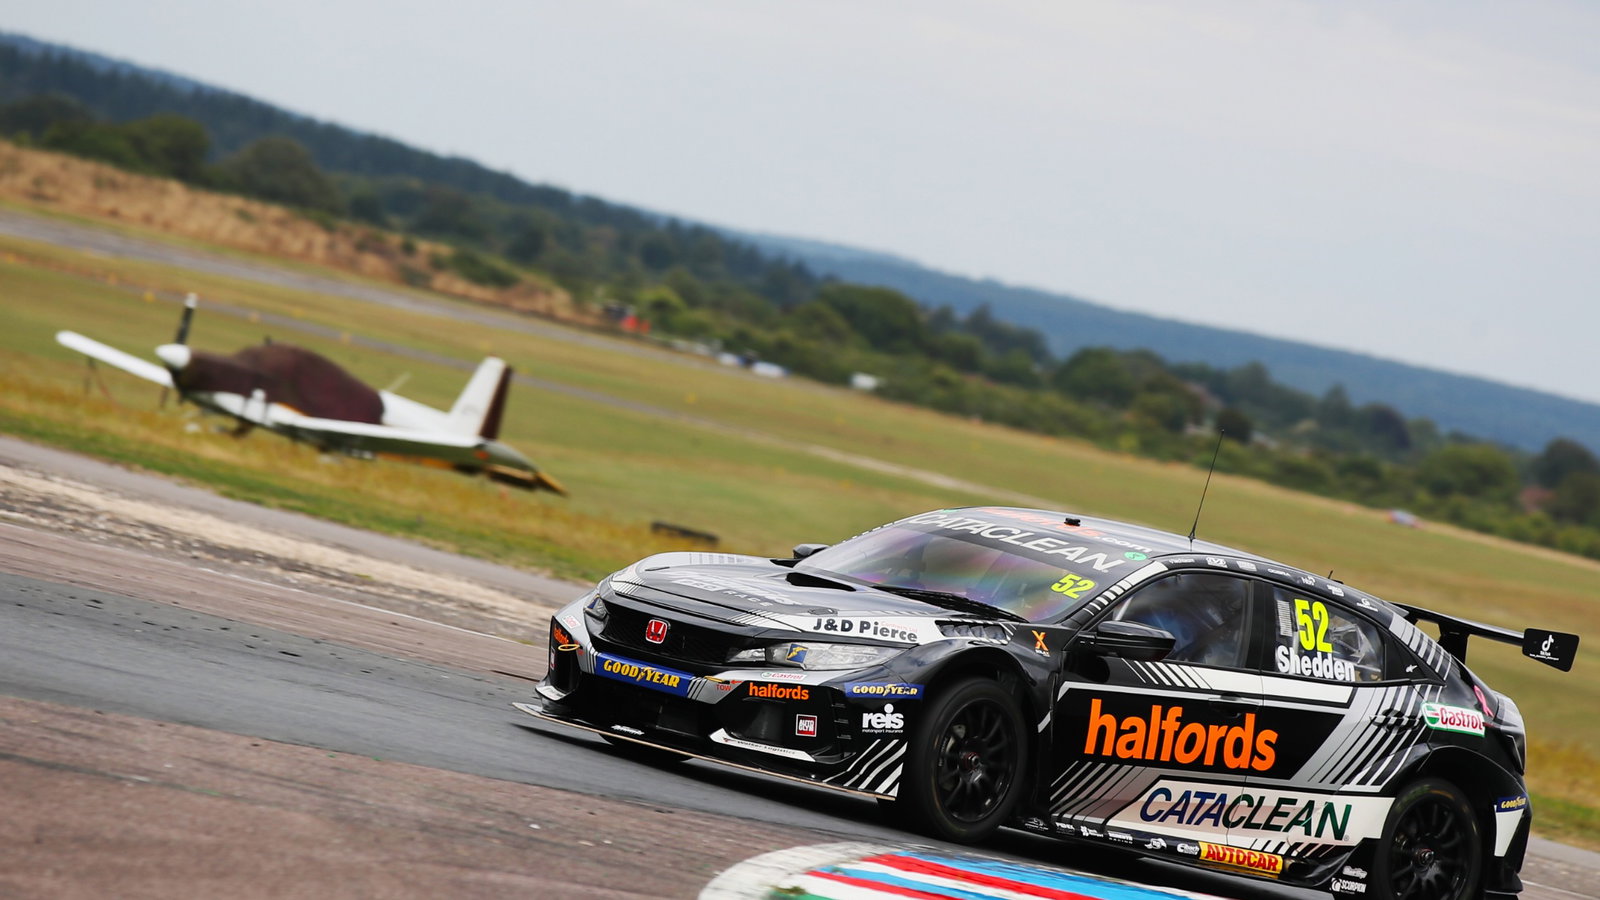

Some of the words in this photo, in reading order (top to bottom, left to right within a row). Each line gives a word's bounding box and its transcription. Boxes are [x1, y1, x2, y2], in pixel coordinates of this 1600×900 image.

[908, 514, 1126, 572] CATACLEAN
[1051, 573, 1096, 600] 52
[813, 618, 854, 632] J&D
[859, 620, 918, 642] Pierce
[1294, 598, 1333, 653] 52
[603, 659, 680, 688] GOODYEAR
[1276, 645, 1356, 682] Shedden
[749, 682, 810, 700] halfords
[852, 683, 918, 697] GOODYEAR
[862, 703, 904, 729] reis
[1439, 707, 1483, 731] Castrol
[1083, 698, 1279, 772] halfords
[1139, 787, 1353, 842] CATACLEAN
[1205, 843, 1279, 872] AUTOCAR
